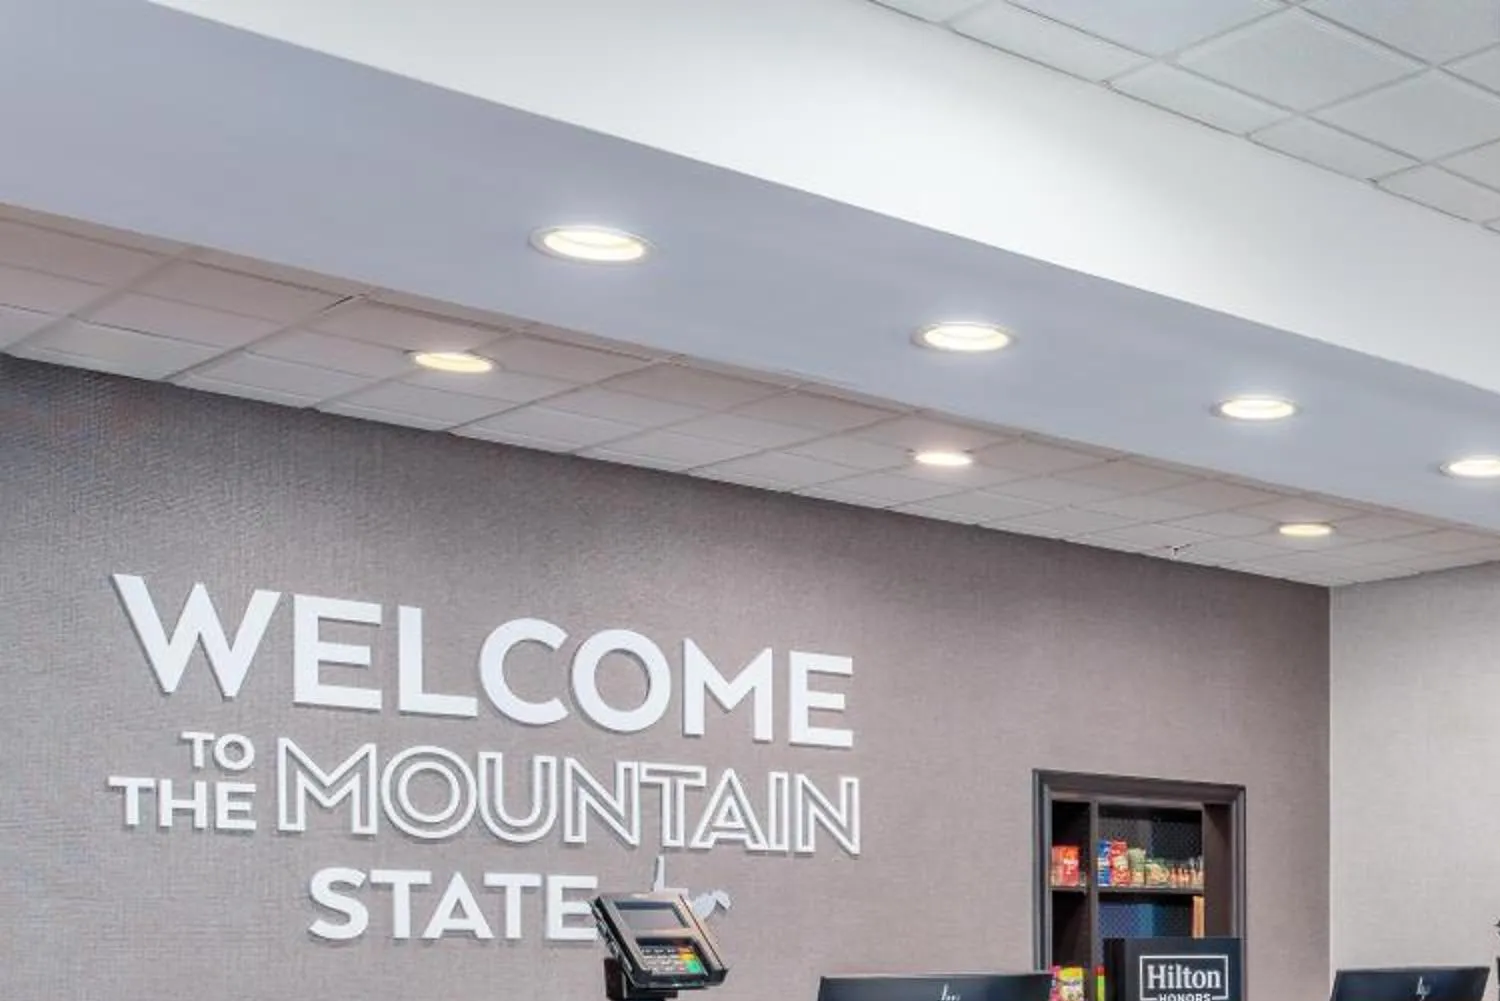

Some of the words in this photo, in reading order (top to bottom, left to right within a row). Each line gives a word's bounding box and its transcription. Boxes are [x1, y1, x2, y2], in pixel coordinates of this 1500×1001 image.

[113, 573, 854, 747] WELCOME
[181, 731, 255, 770] TO
[108, 776, 256, 830] THE
[277, 736, 861, 855] MOUNTAIN
[308, 867, 598, 941] STATE
[1147, 963, 1221, 989] Hilton
